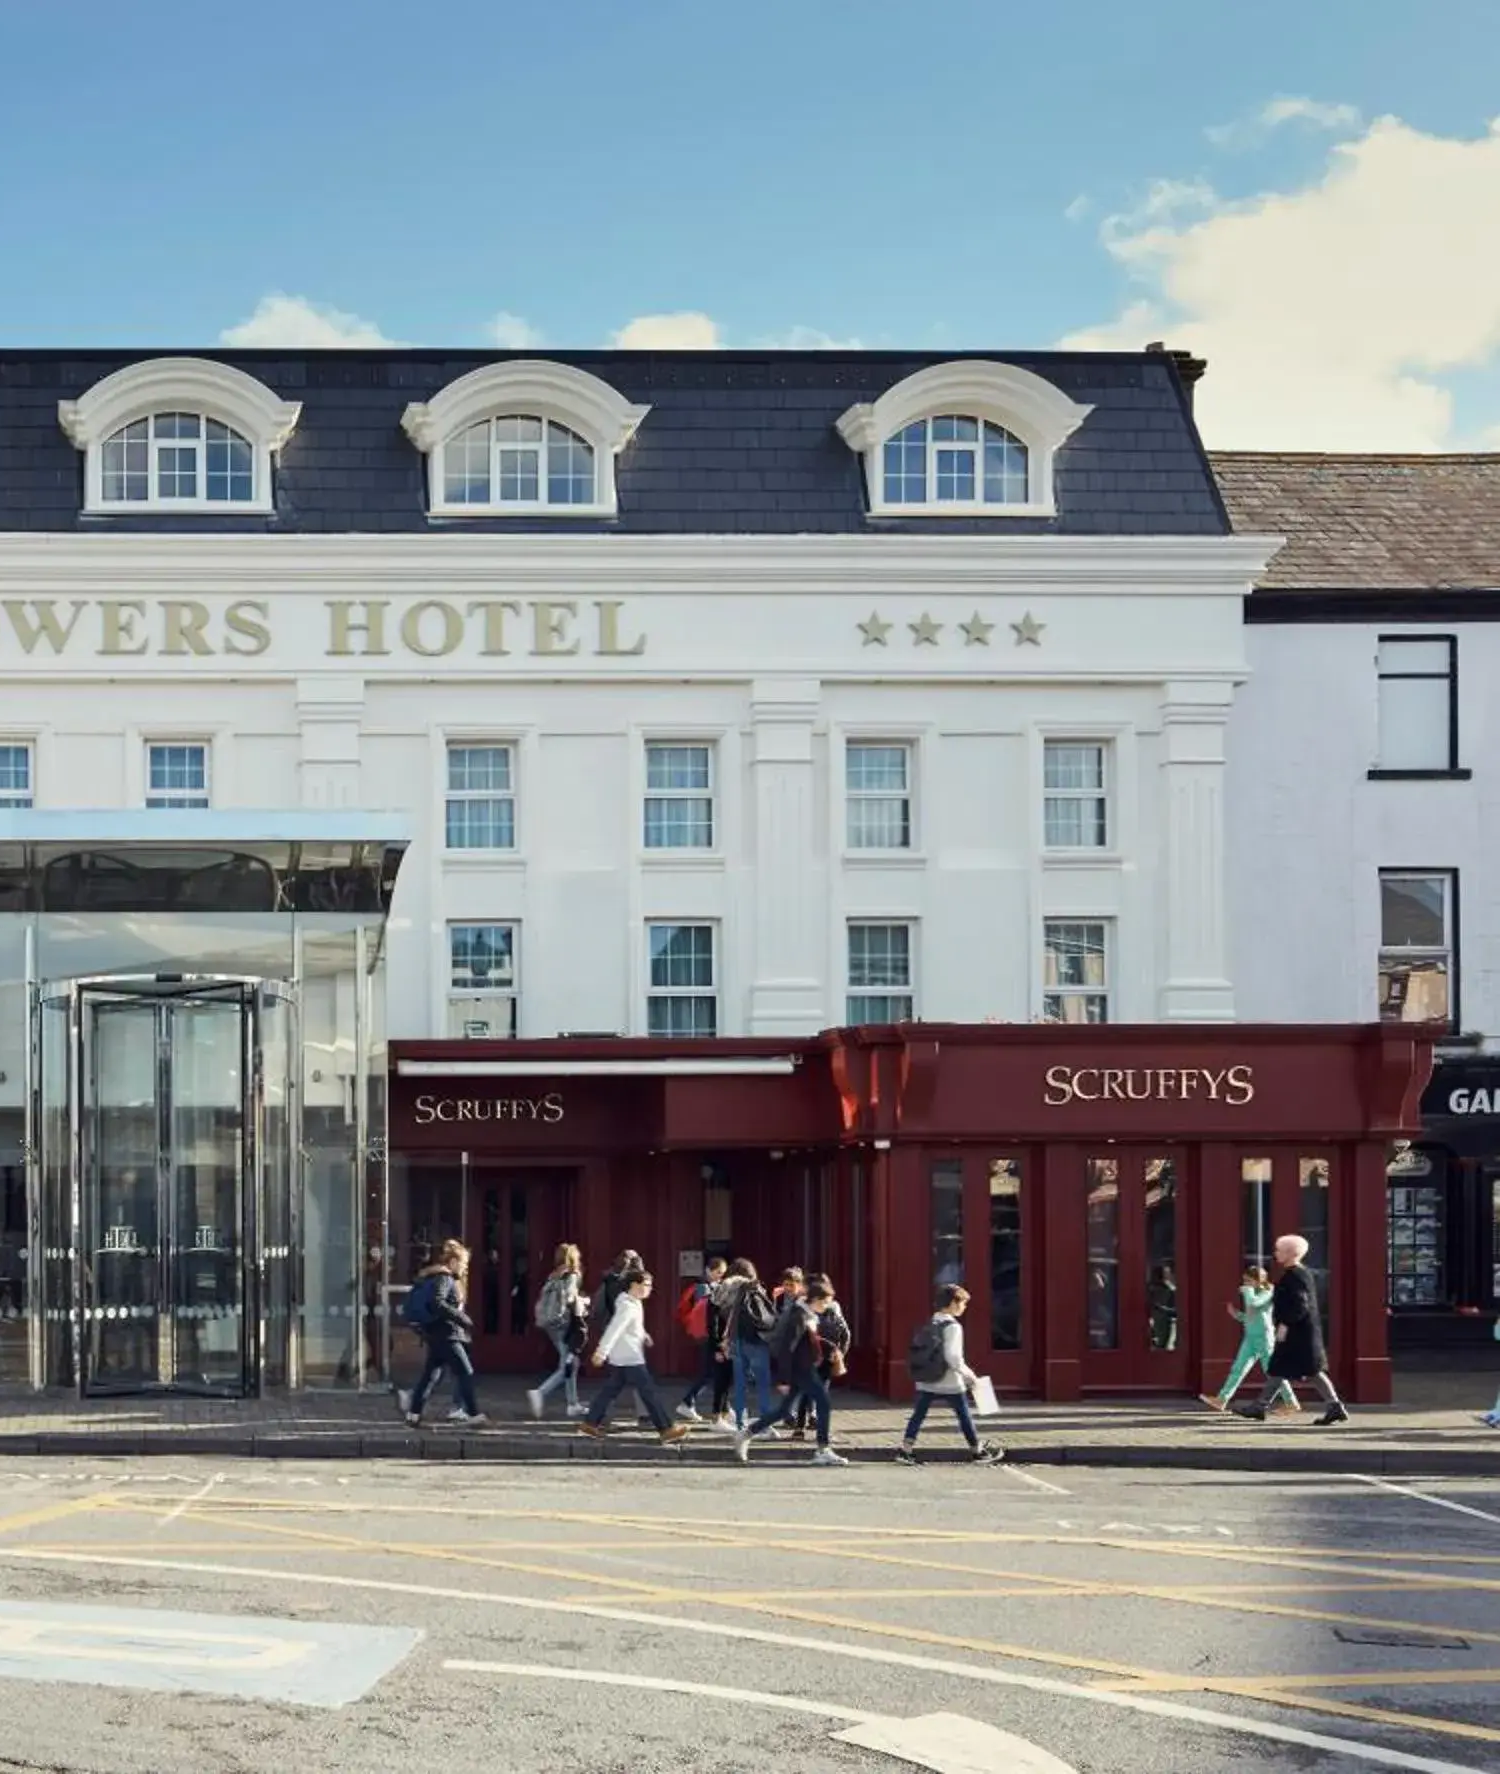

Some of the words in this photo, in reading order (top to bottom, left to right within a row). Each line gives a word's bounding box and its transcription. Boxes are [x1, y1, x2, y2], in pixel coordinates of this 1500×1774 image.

[324, 599, 647, 657] HOTEL
[1043, 1065, 1254, 1105] SCRUFFYS
[414, 1092, 565, 1123] SCRUFFYS
